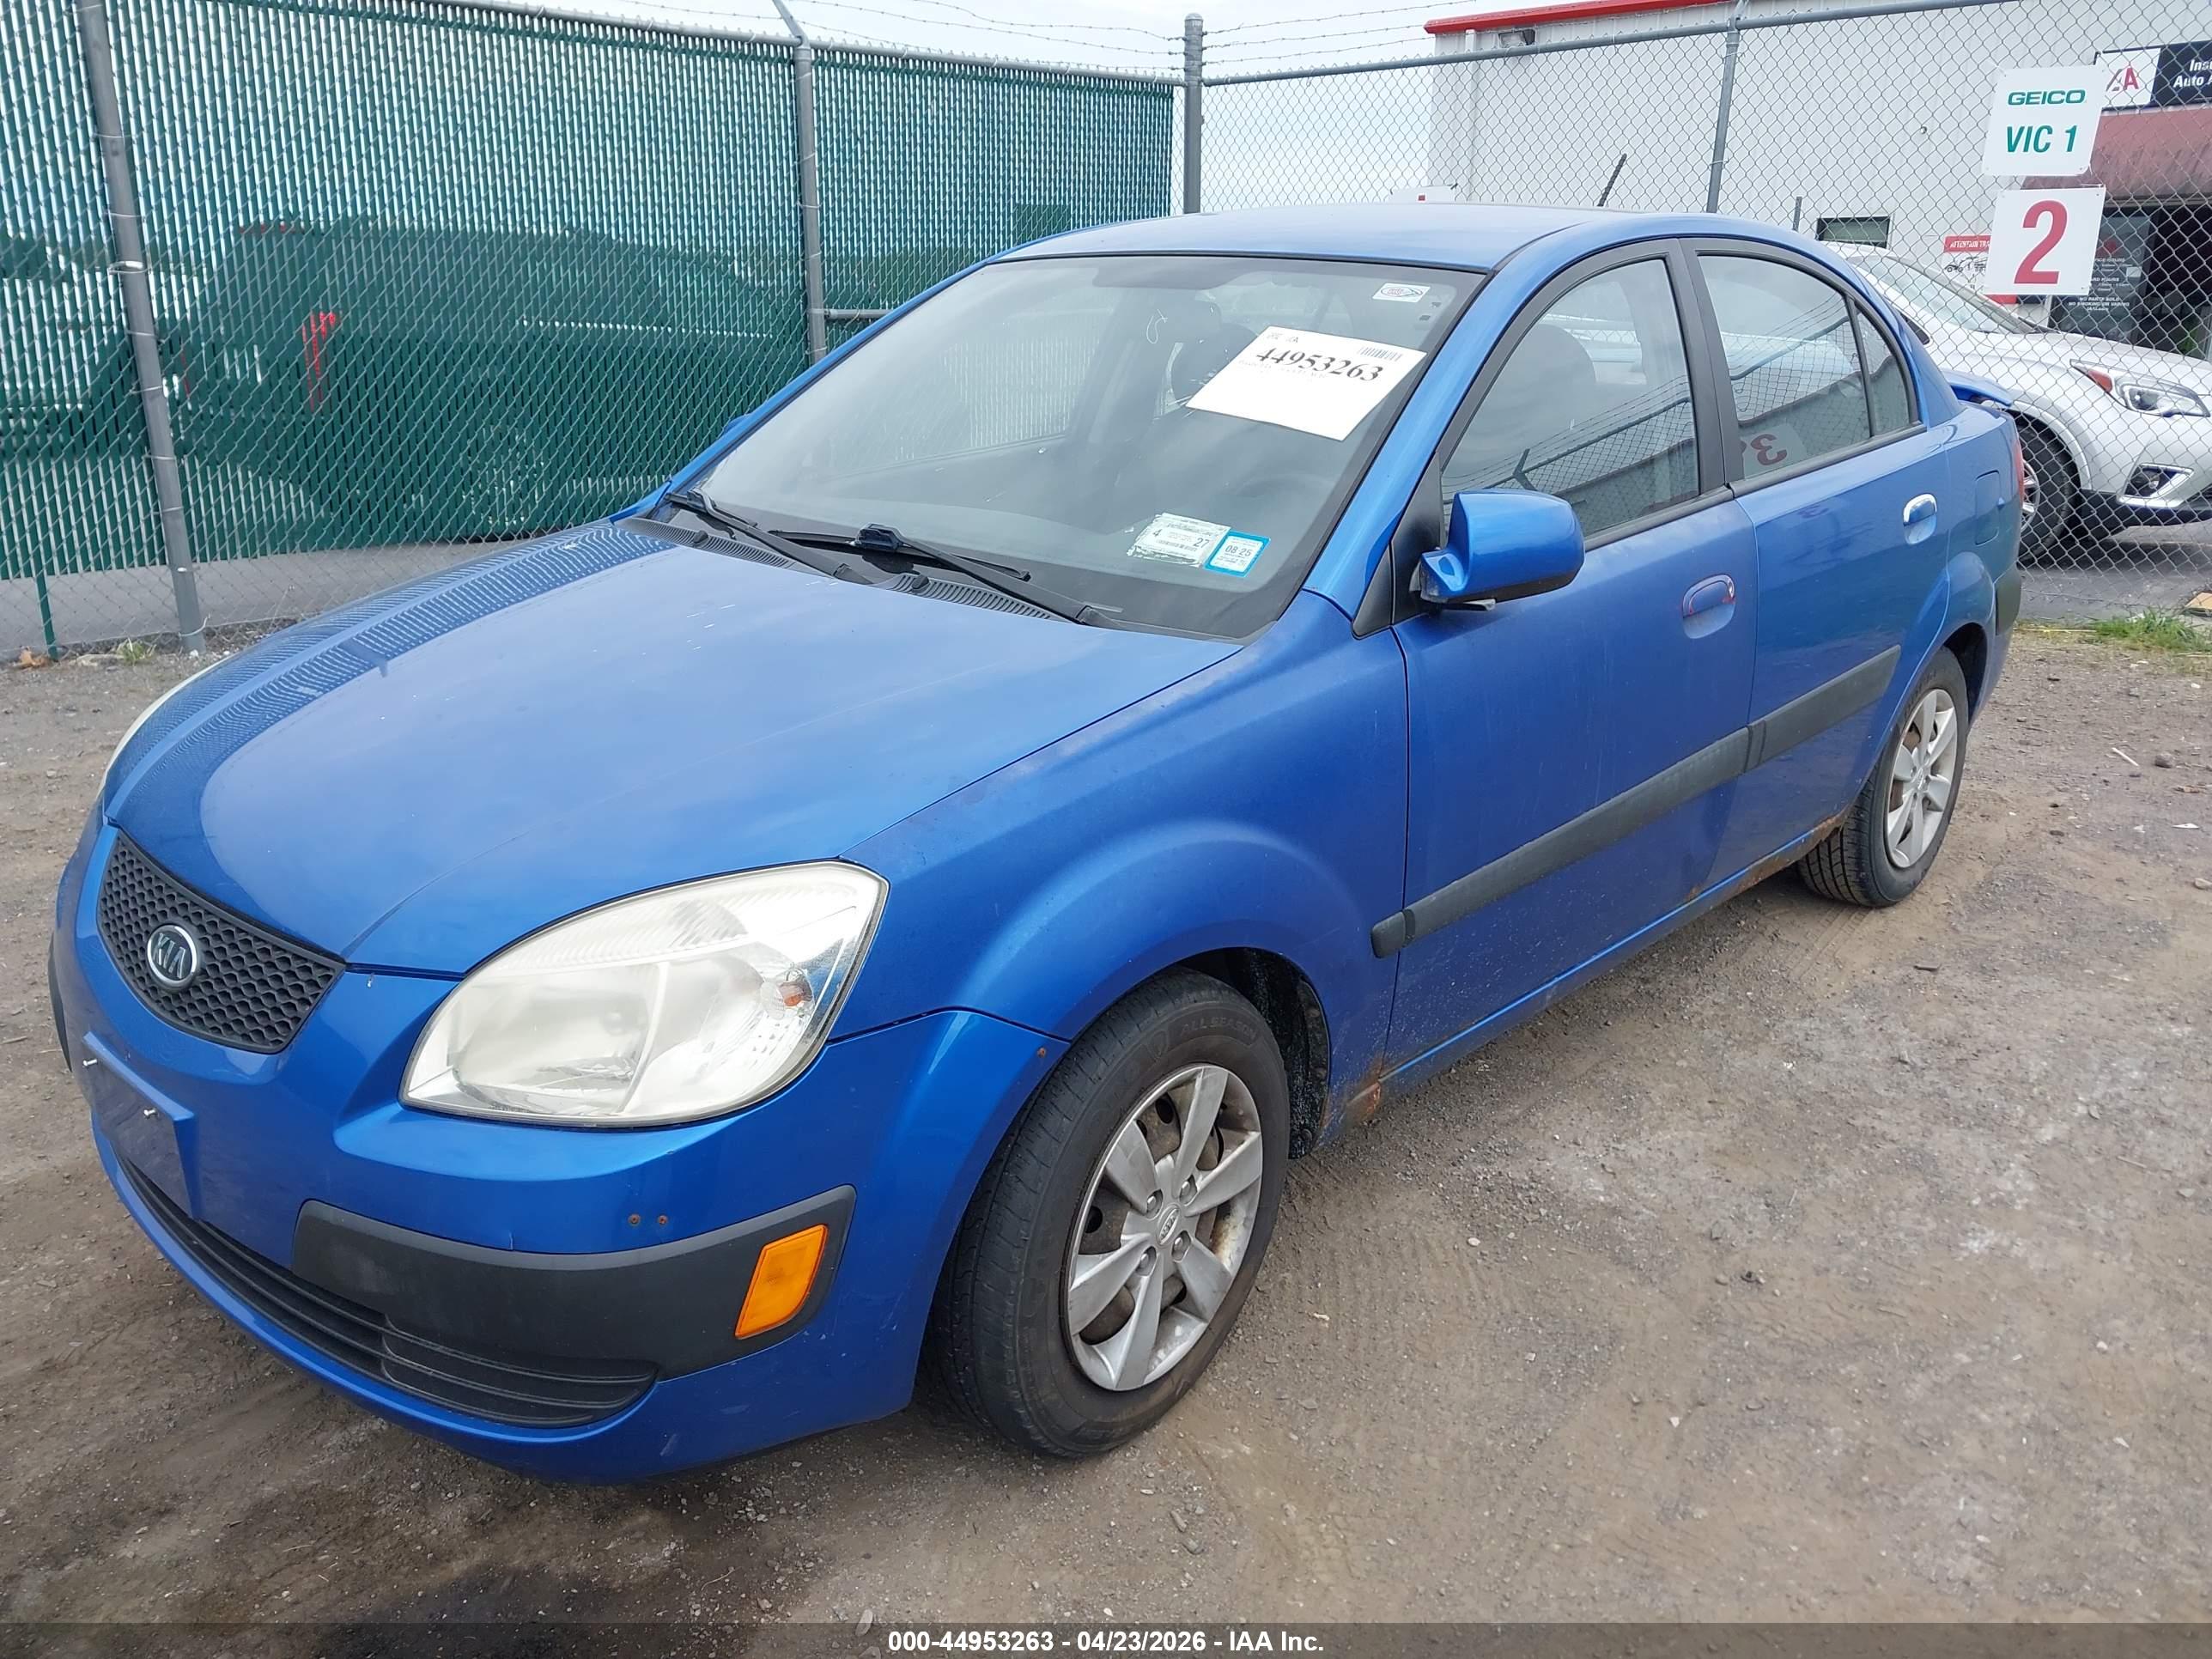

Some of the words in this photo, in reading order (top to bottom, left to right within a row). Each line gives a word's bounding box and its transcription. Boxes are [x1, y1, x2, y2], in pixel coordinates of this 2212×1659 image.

[2172, 75, 2204, 88] Auto
[2008, 89, 2086, 106] GEICO
[2006, 125, 2053, 153] VIC
[2065, 125, 2078, 153] 1
[2014, 199, 2069, 284] 2
[1256, 347, 1383, 381] 44953263
[1152, 528, 1163, 537] 4
[1193, 537, 1210, 549] 27
[152, 933, 186, 980] KIA
